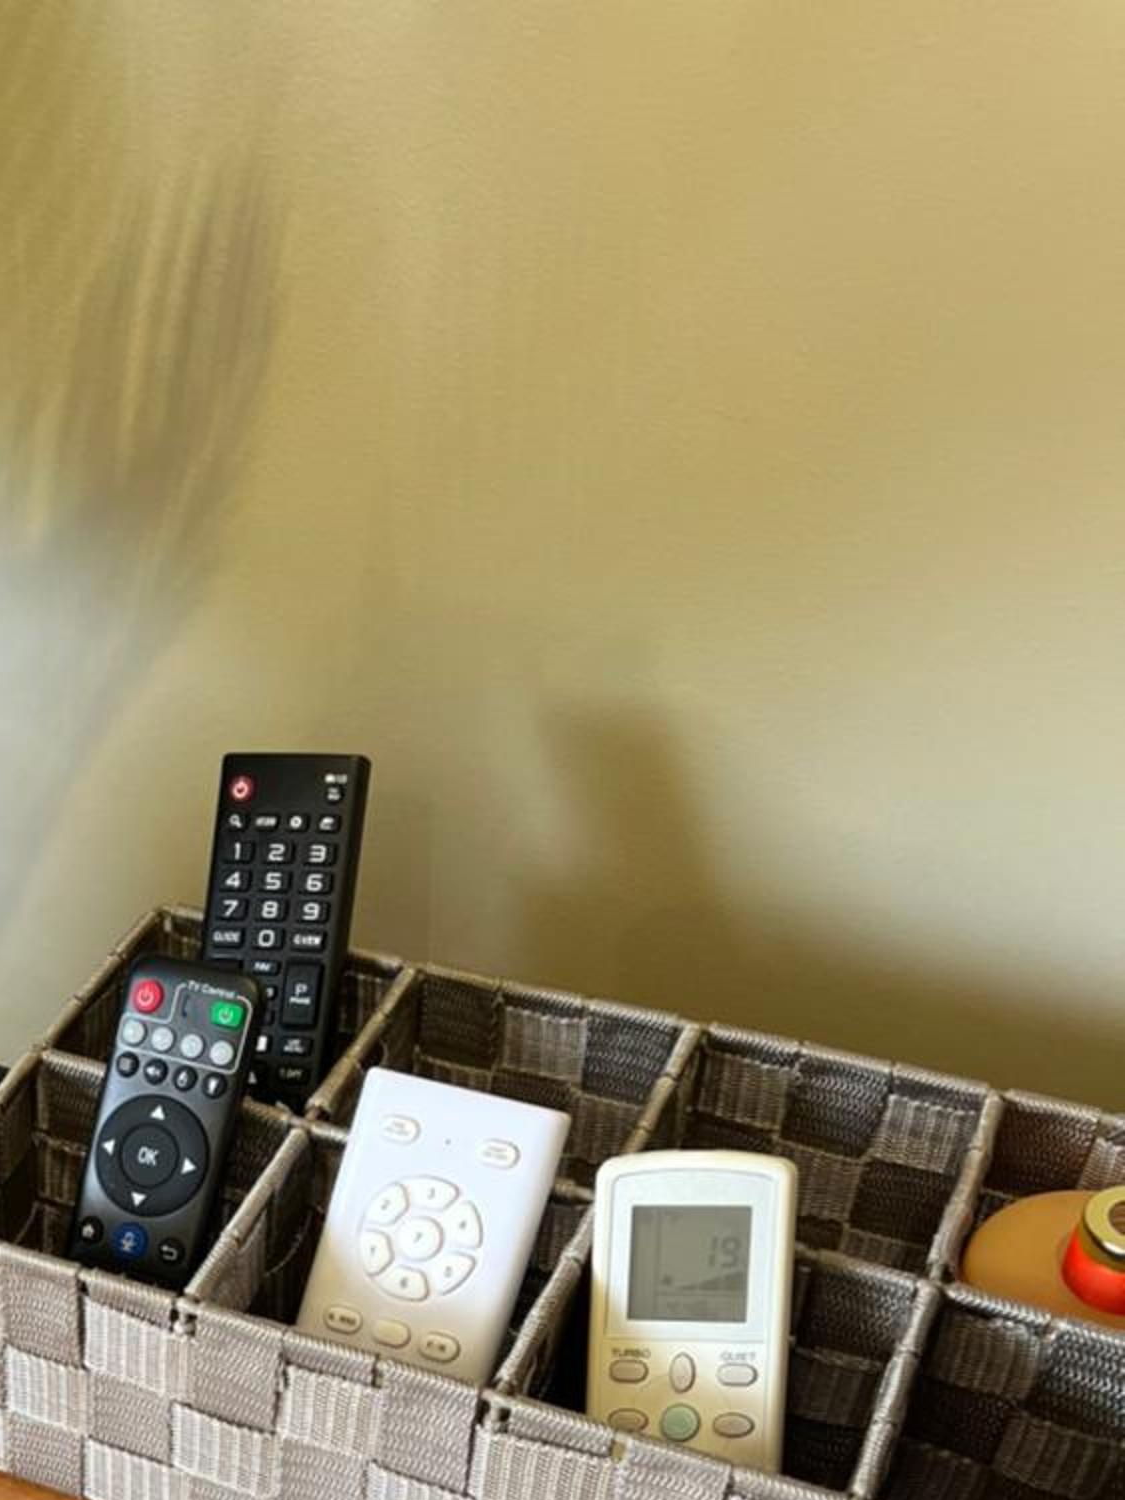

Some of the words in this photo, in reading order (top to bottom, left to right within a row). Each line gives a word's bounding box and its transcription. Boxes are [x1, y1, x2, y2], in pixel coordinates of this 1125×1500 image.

[234, 842, 241, 861] 1
[268, 844, 285, 862] 2
[308, 845, 327, 863] 3
[225, 873, 241, 888] 4
[265, 873, 282, 891] 5
[305, 873, 323, 891] 6
[224, 900, 239, 917] 7
[261, 900, 278, 918] 8
[303, 903, 320, 920] 9
[188, 980, 200, 991] TV
[201, 983, 235, 998] Control
[295, 983, 308, 995] P
[137, 1147, 160, 1166] OK
[709, 1236, 741, 1267] 19
